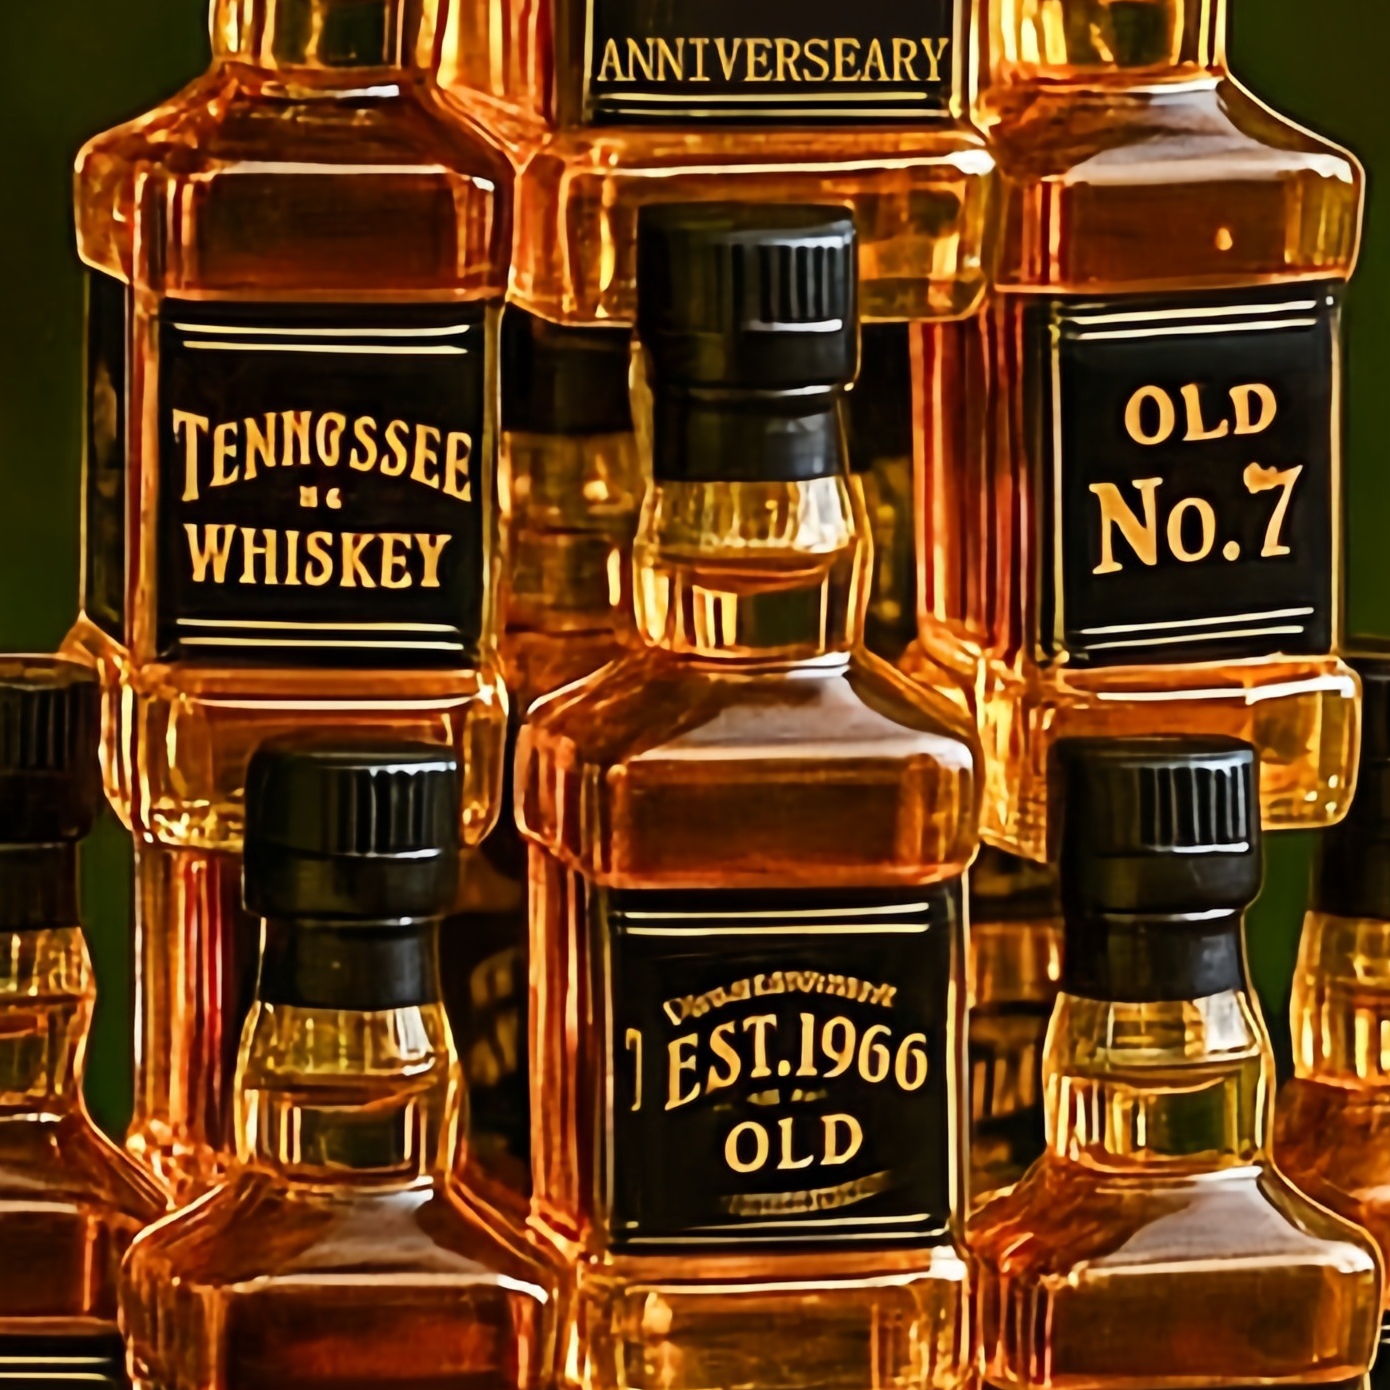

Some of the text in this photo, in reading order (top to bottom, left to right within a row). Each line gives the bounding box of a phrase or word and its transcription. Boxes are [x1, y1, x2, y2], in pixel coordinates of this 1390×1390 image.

[596, 37, 950, 83] ANNIVERSEARY
[1124, 382, 1277, 446] OLD
[183, 523, 453, 589] WHISKEY
[663, 1011, 928, 1111] EST.1966
[724, 1113, 864, 1173] OLD
